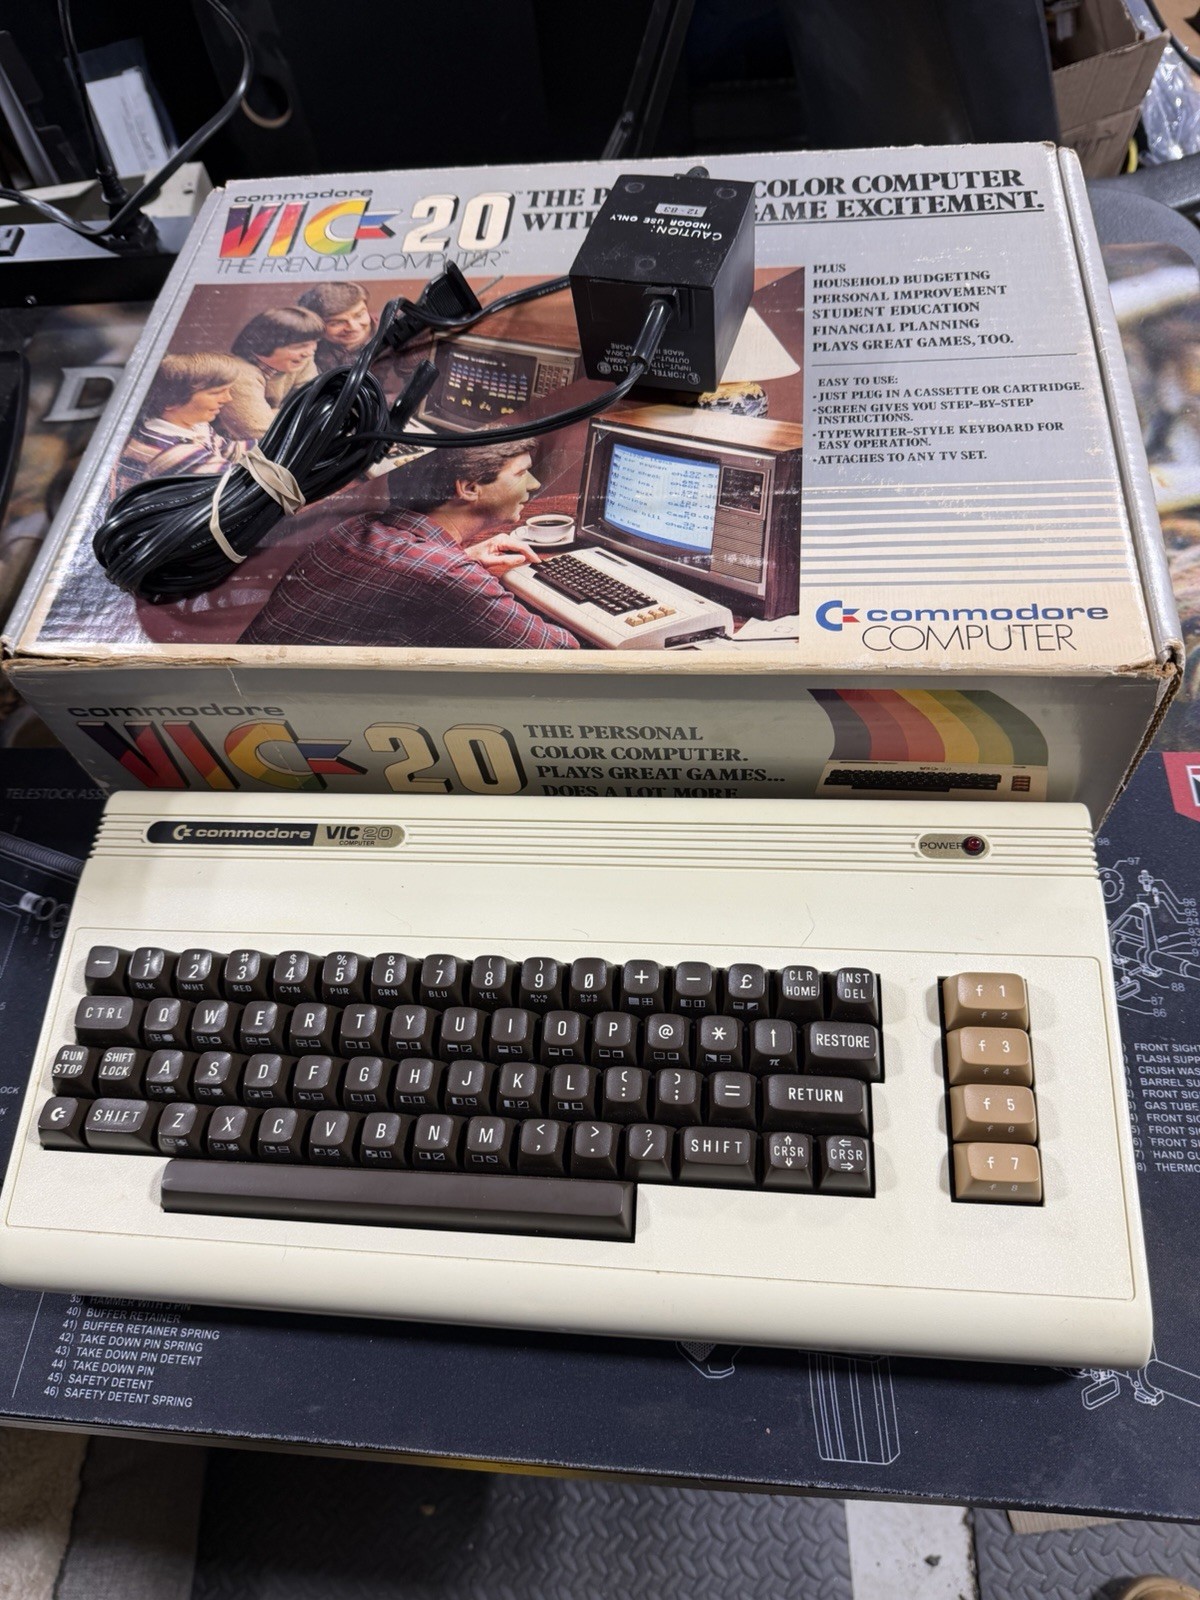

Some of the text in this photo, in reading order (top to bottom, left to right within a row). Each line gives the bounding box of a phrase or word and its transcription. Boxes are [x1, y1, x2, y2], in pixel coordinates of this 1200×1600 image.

[754, 169, 1024, 198] COLOR COMPUTER
[234, 187, 373, 203] commodore
[525, 189, 595, 207] THE
[836, 190, 1044, 217] EXCITEMENT.
[609, 214, 638, 222] ONLY
[669, 219, 711, 229] INDOOR
[219, 191, 516, 259] VIC 20
[651, 225, 722, 241] CAUTION:
[216, 249, 501, 274] THE FRIENDLY COMPUTER
[813, 264, 846, 274] PLUS
[813, 270, 991, 289] HOUSEHOLD BUDGETING
[813, 285, 1007, 304] PERSONAL IMPROVEMENT
[813, 302, 980, 319] STUDENT EDUCATION
[812, 319, 979, 336] FINANCIAL PLANNING
[812, 333, 1014, 352] PLAYS GREAT GAMES, TOO.
[818, 375, 898, 387] EASY TO USE:
[852, 389, 882, 400] PLUG
[886, 388, 900, 398] IN
[903, 388, 912, 398] A
[914, 385, 979, 398] CASSETTE
[982, 385, 1000, 396] OR
[1002, 381, 1085, 394] CARTRIDGE.
[870, 402, 909, 413] GIVES
[912, 401, 937, 411] YOU
[940, 398, 1034, 410] STEP-BY-STEP
[818, 413, 914, 425] INSTRUCTIONS.
[959, 422, 1034, 435] KEYBOARD
[1037, 421, 1064, 432] FOR
[818, 437, 932, 450] EASY OPERATION.
[886, 452, 905, 463] TO
[907, 452, 935, 462] ANY
[938, 451, 957, 461] TV
[960, 450, 987, 460] SET.
[866, 603, 1109, 622] commodore
[861, 624, 1077, 652] COMPUTER
[68, 703, 285, 718] commodore
[523, 724, 704, 741] THE PERSONAL
[77, 718, 529, 795] VIC 20
[531, 745, 749, 763] COLOR COMPUTER.
[536, 764, 786, 783] PLAYS GREAT GAMES...
[541, 784, 599, 797] DOES
[605, 786, 619, 797] A
[624, 787, 666, 798] LOT
[196, 825, 394, 840] commodore VIC 20
[919, 841, 964, 851] POWER
[1127, 857, 1141, 865] 97
[789, 970, 813, 981] CLR
[841, 973, 870, 984] INST
[182, 983, 204, 991] WHT
[233, 984, 252, 992] RED
[279, 986, 300, 994] CYN
[330, 987, 349, 995] PUR
[378, 989, 398, 997] GRN
[786, 986, 817, 997] HOME
[844, 988, 866, 999] DEL
[1171, 983, 1185, 991] 88
[429, 990, 447, 998] BLU
[479, 991, 498, 999] YEL
[1151, 997, 1164, 1005] 87
[85, 1007, 123, 1019] CTRL
[159, 1008, 169, 1022] Q
[204, 1010, 220, 1024] W
[255, 1010, 266, 1025] E
[1152, 1009, 1167, 1017] 86
[304, 1013, 315, 1028] R
[356, 1014, 365, 1028] T
[406, 1015, 415, 1030] Y
[816, 1034, 870, 1048] RESTORE
[1134, 1043, 1169, 1052] FRONT
[61, 1051, 83, 1061] RUN
[105, 1052, 133, 1063] SHIFT
[1136, 1054, 1171, 1063] FLASH
[53, 1064, 82, 1074] STOP
[102, 1065, 128, 1076] LOCK
[1138, 1066, 1175, 1075] CRUSH
[1140, 1078, 1184, 1087] BARREL
[788, 1087, 843, 1102] RETURN
[1142, 1090, 1178, 1099] FRONT
[1144, 1101, 1199, 1111] GAS TUBE
[93, 1110, 140, 1122] SHIFT
[1146, 1114, 1183, 1123] FRONT
[1149, 1126, 1186, 1135] FRONT
[691, 1139, 742, 1154] SHIFT
[1151, 1138, 1187, 1147] FRONT
[773, 1145, 804, 1157] CRSR
[830, 1148, 863, 1160] CRSR
[1153, 1150, 1184, 1159] HAND
[66, 1307, 181, 1324] 40) BUFFER RETAINER
[62, 1320, 220, 1340] 41) BUFFER RETAINER SPRING
[59, 1333, 203, 1352] 42) TAKE DOWN PIN SPRING
[55, 1346, 203, 1366] 43) TAKE DOWN PIN DETENT
[51, 1359, 154, 1376] 44) TAKE DOWN PIN
[47, 1372, 154, 1390] 45) SAFETY DETENT
[43, 1386, 193, 1408] 46) SAFETY DETENT SPRING
